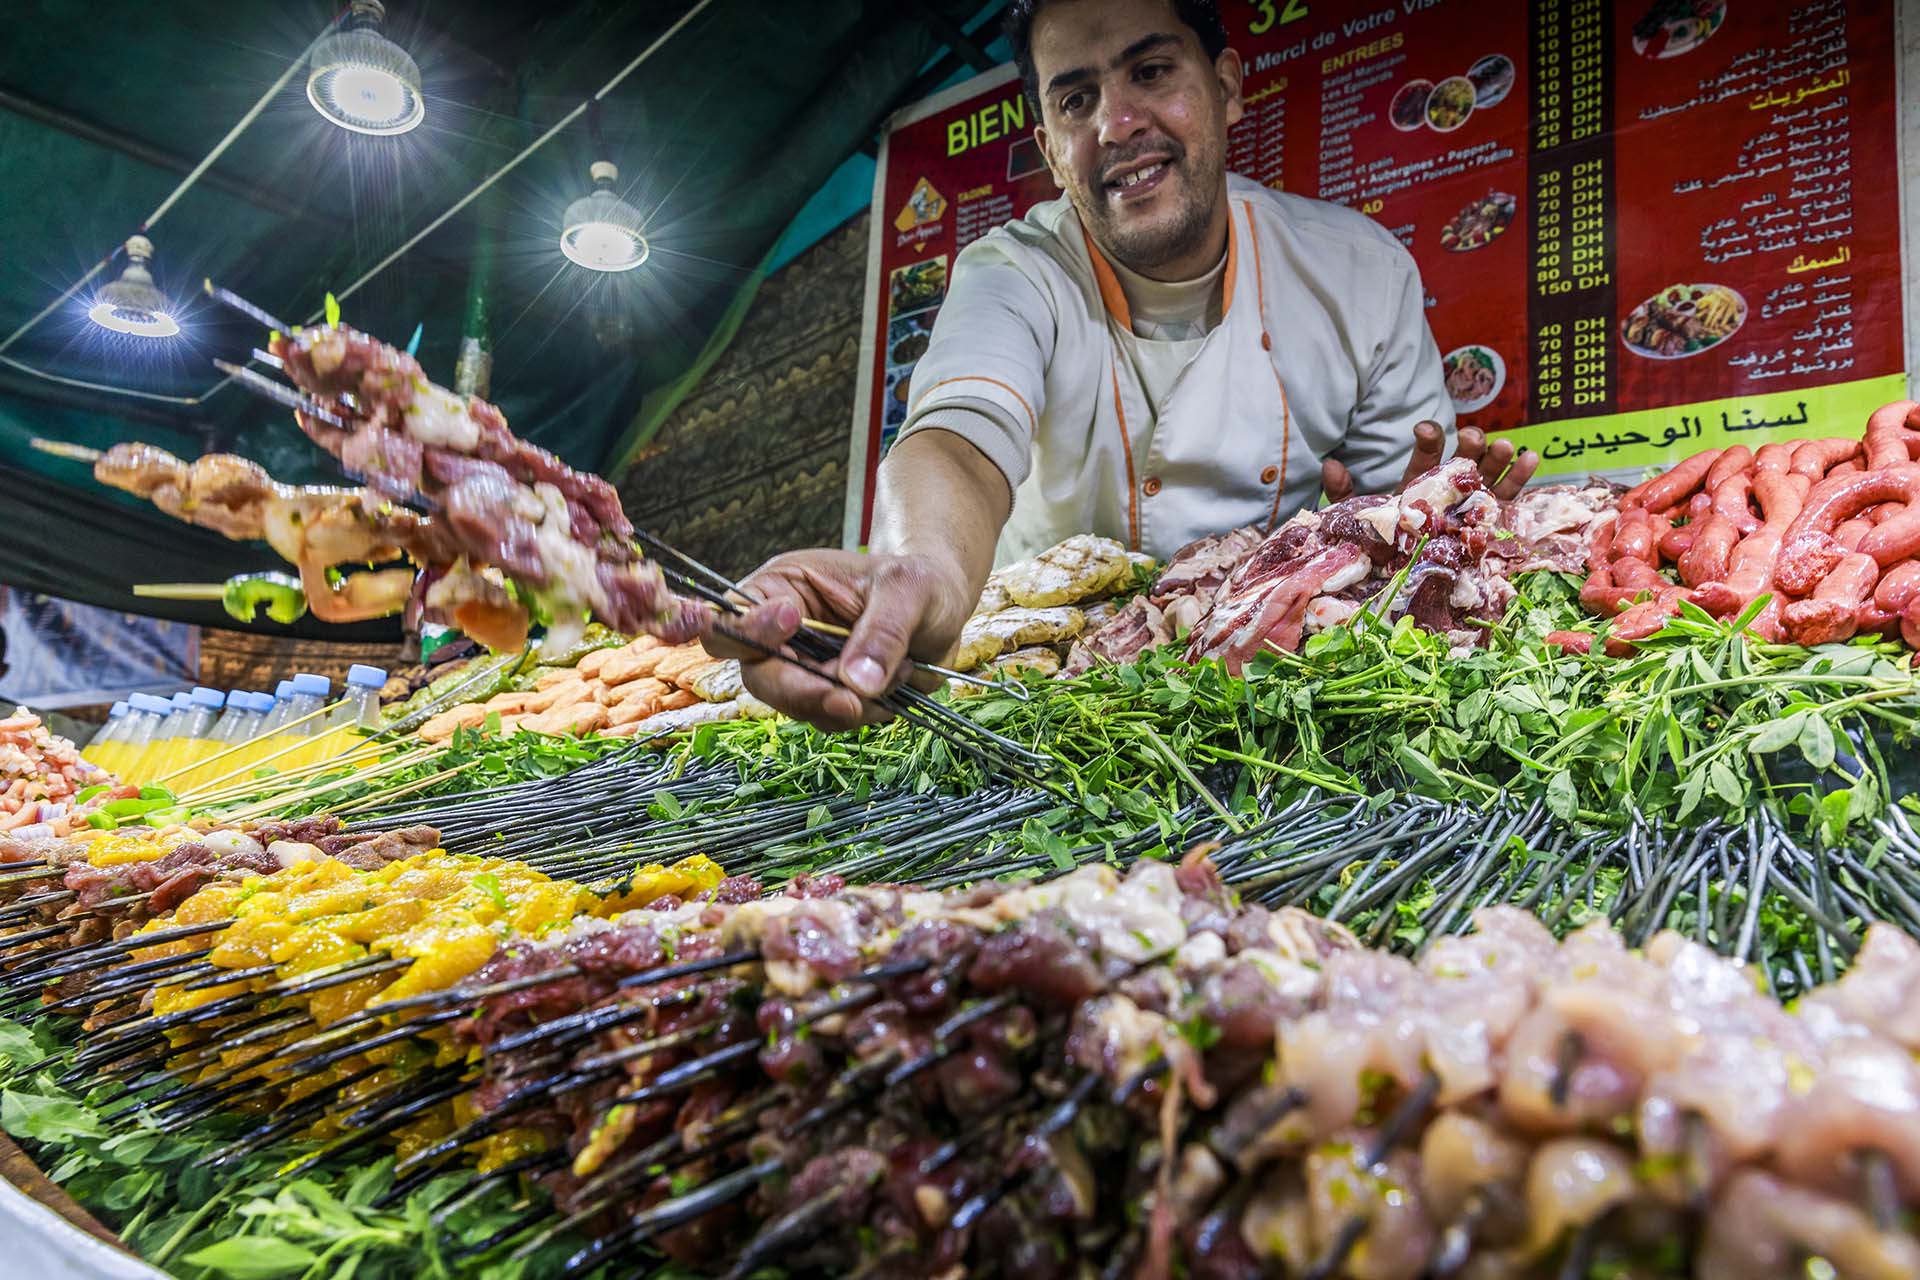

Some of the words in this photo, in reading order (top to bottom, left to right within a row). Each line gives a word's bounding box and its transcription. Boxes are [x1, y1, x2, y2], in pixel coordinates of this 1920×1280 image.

[1538, 11, 1559, 25] 10
[1538, 24, 1559, 39] 10
[1571, 10, 1602, 30] DH
[1255, 39, 1307, 73] Merci
[1312, 31, 1336, 50] de
[1342, 9, 1396, 38] Votre
[1538, 38, 1560, 53] 10
[1571, 24, 1602, 44] DH
[1321, 32, 1404, 75] ENTREES
[1538, 52, 1560, 66] 10
[1571, 38, 1602, 57] DH
[1538, 66, 1560, 80] 10
[1571, 53, 1602, 72] DH
[1538, 80, 1560, 94] 10
[1571, 67, 1602, 86] DH
[1749, 69, 1850, 111] المشويات
[1538, 93, 1560, 108] 10
[1571, 81, 1602, 100] DH
[1538, 107, 1560, 122] 10
[1571, 94, 1602, 113] DH
[1537, 121, 1560, 137] 20
[1571, 108, 1602, 127] DH
[1571, 122, 1602, 140] DH
[1319, 181, 1357, 198] Galette
[1369, 158, 1435, 184] Aubergines
[1447, 141, 1498, 162] Peppers
[1319, 168, 1353, 186] Sauce
[1355, 164, 1367, 175] et
[1368, 157, 1395, 173] pain
[1572, 159, 1603, 177] DH
[1537, 184, 1561, 199] 40
[1572, 173, 1603, 191] DH
[1538, 198, 1561, 213] 70
[1572, 187, 1603, 205] DH
[1538, 212, 1561, 228] 50
[1572, 202, 1603, 219] DH
[1538, 226, 1561, 241] 50
[1572, 216, 1603, 233] DH
[1537, 240, 1561, 254] 40
[1572, 231, 1603, 247] DH
[1537, 253, 1561, 268] 40
[1572, 245, 1603, 262] DH
[1786, 246, 1851, 274] السمك
[1537, 267, 1561, 283] 80
[1572, 260, 1603, 276] DH
[1812, 275, 1852, 288] سمك
[1538, 279, 1573, 296] 150
[1578, 273, 1610, 290] DH
[1812, 292, 1852, 304] سمك
[1812, 303, 1852, 324] كلمار
[1538, 323, 1562, 337] 40
[1573, 316, 1606, 332] DH
[1539, 338, 1562, 353] 70
[1573, 330, 1606, 346] DH
[1813, 337, 1854, 357] كلمار
[1538, 352, 1562, 366] 45
[1573, 345, 1606, 361] DH
[1538, 366, 1562, 380] 45
[1573, 360, 1606, 375] DH
[1747, 367, 1786, 379] سمك
[1538, 380, 1562, 395] 60
[1573, 375, 1606, 390] DH
[1539, 395, 1562, 410] 75
[1573, 389, 1606, 405] DH
[1720, 401, 1809, 433] لسنا
[1541, 415, 1703, 460] الوحيدين
